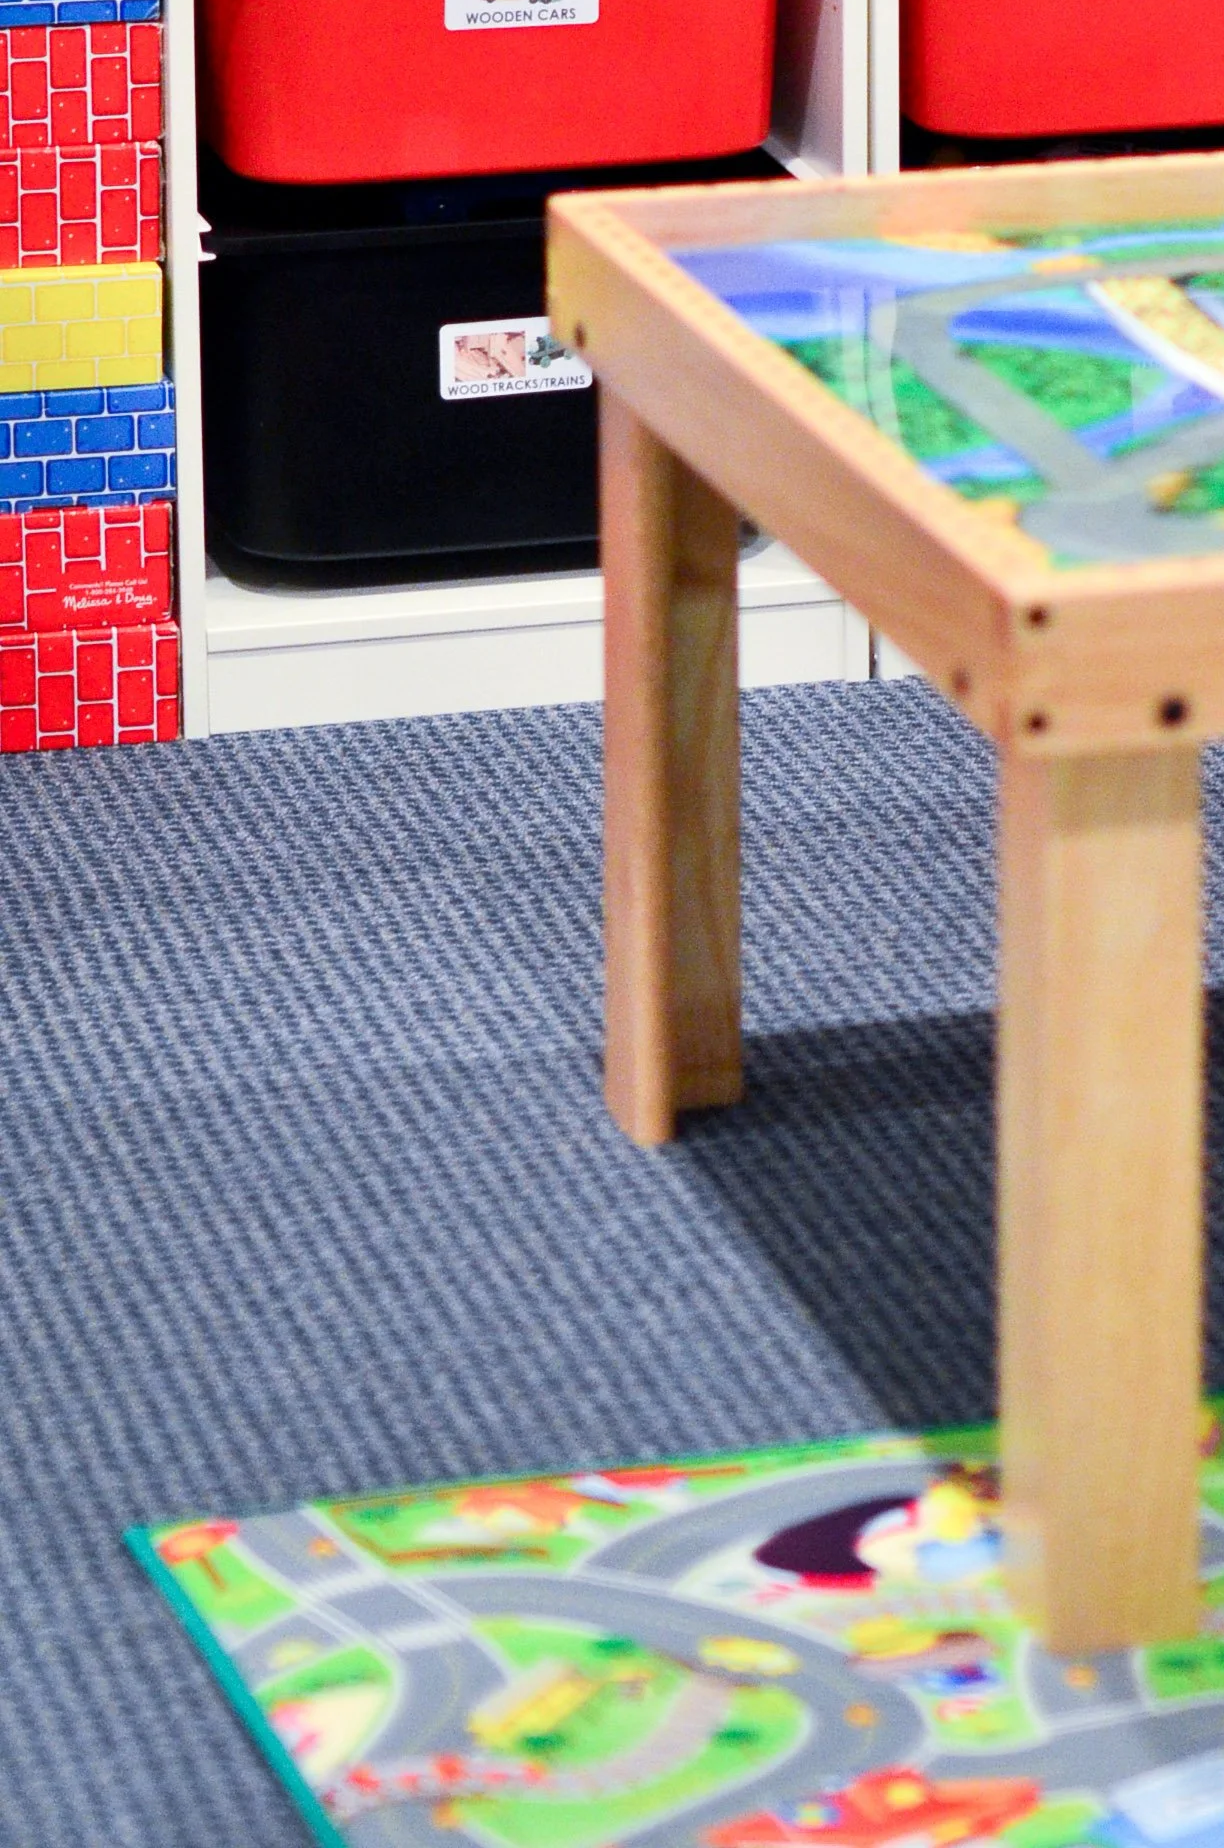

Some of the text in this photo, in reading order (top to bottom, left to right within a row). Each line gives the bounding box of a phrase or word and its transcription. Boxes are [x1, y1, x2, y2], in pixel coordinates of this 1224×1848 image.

[466, 8, 577, 24] WOODEN CARS
[448, 382, 490, 397] WOOD
